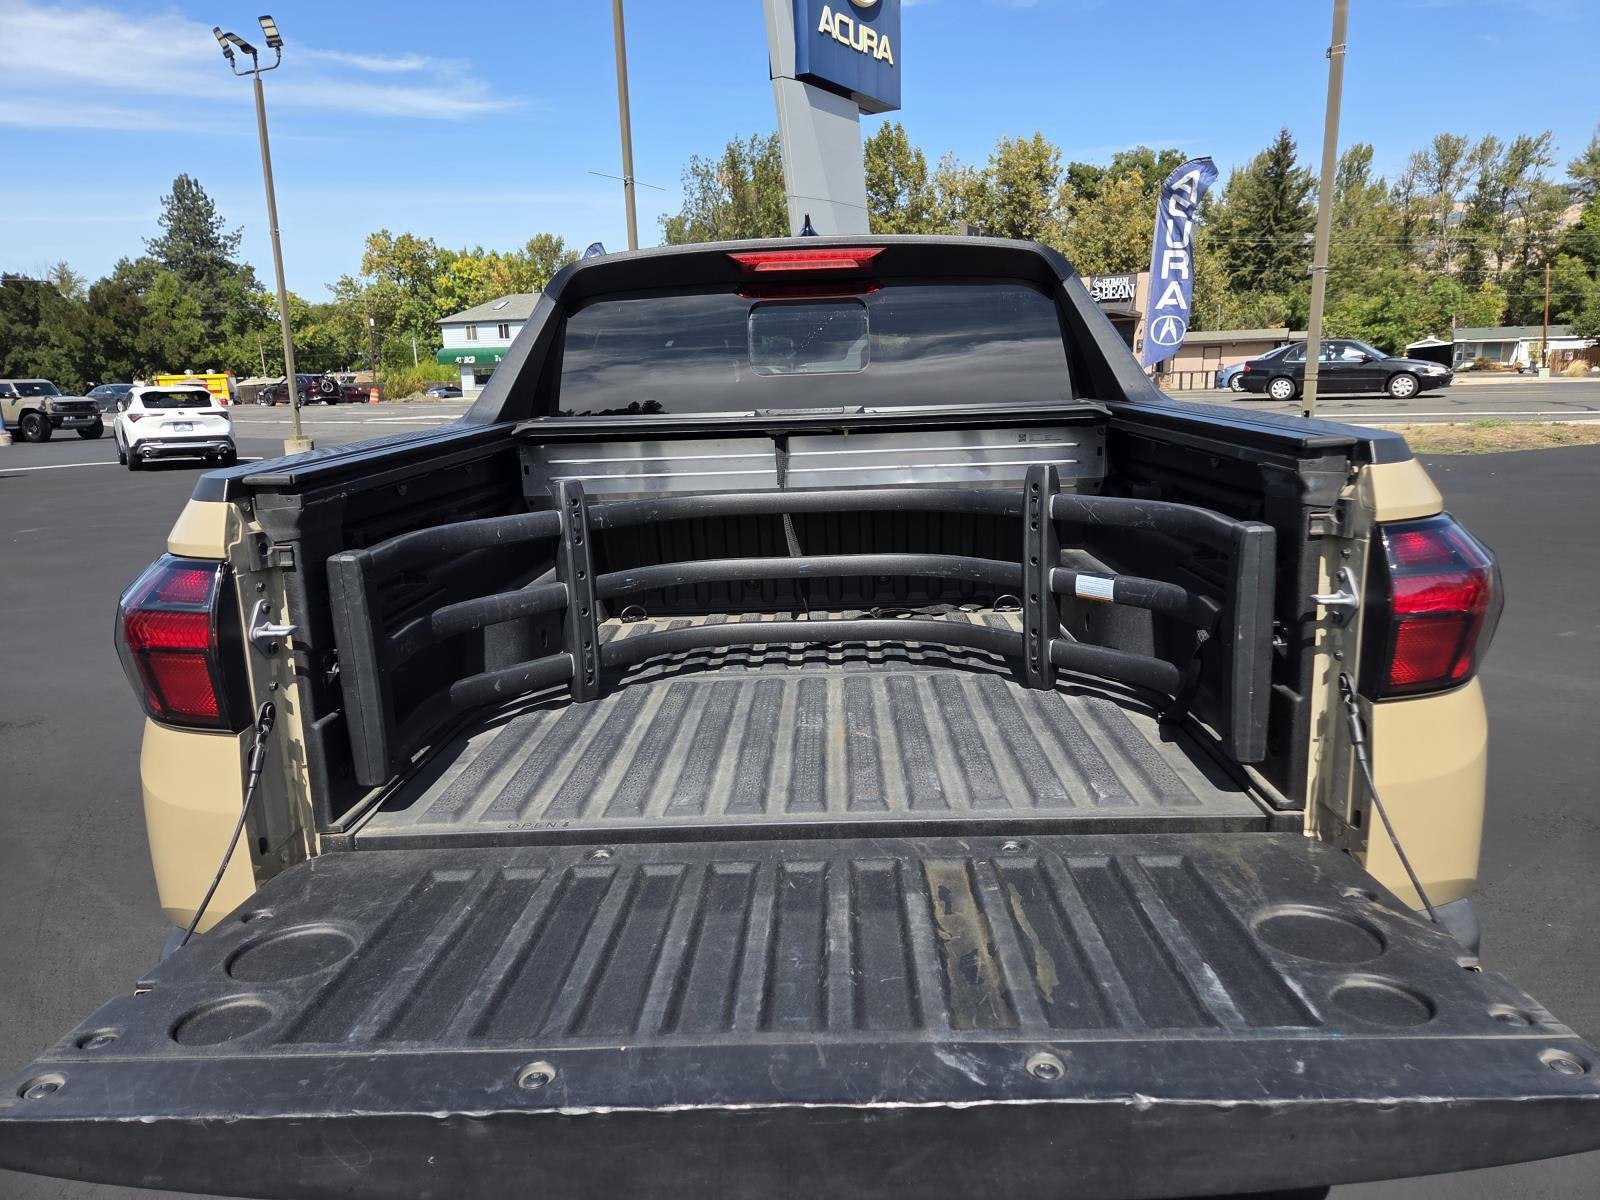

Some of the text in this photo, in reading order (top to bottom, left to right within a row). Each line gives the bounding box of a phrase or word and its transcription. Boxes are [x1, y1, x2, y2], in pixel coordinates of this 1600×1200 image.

[818, 5, 893, 65] ACURA
[1155, 169, 1201, 310] ACURA
[1102, 284, 1135, 299] BEAN
